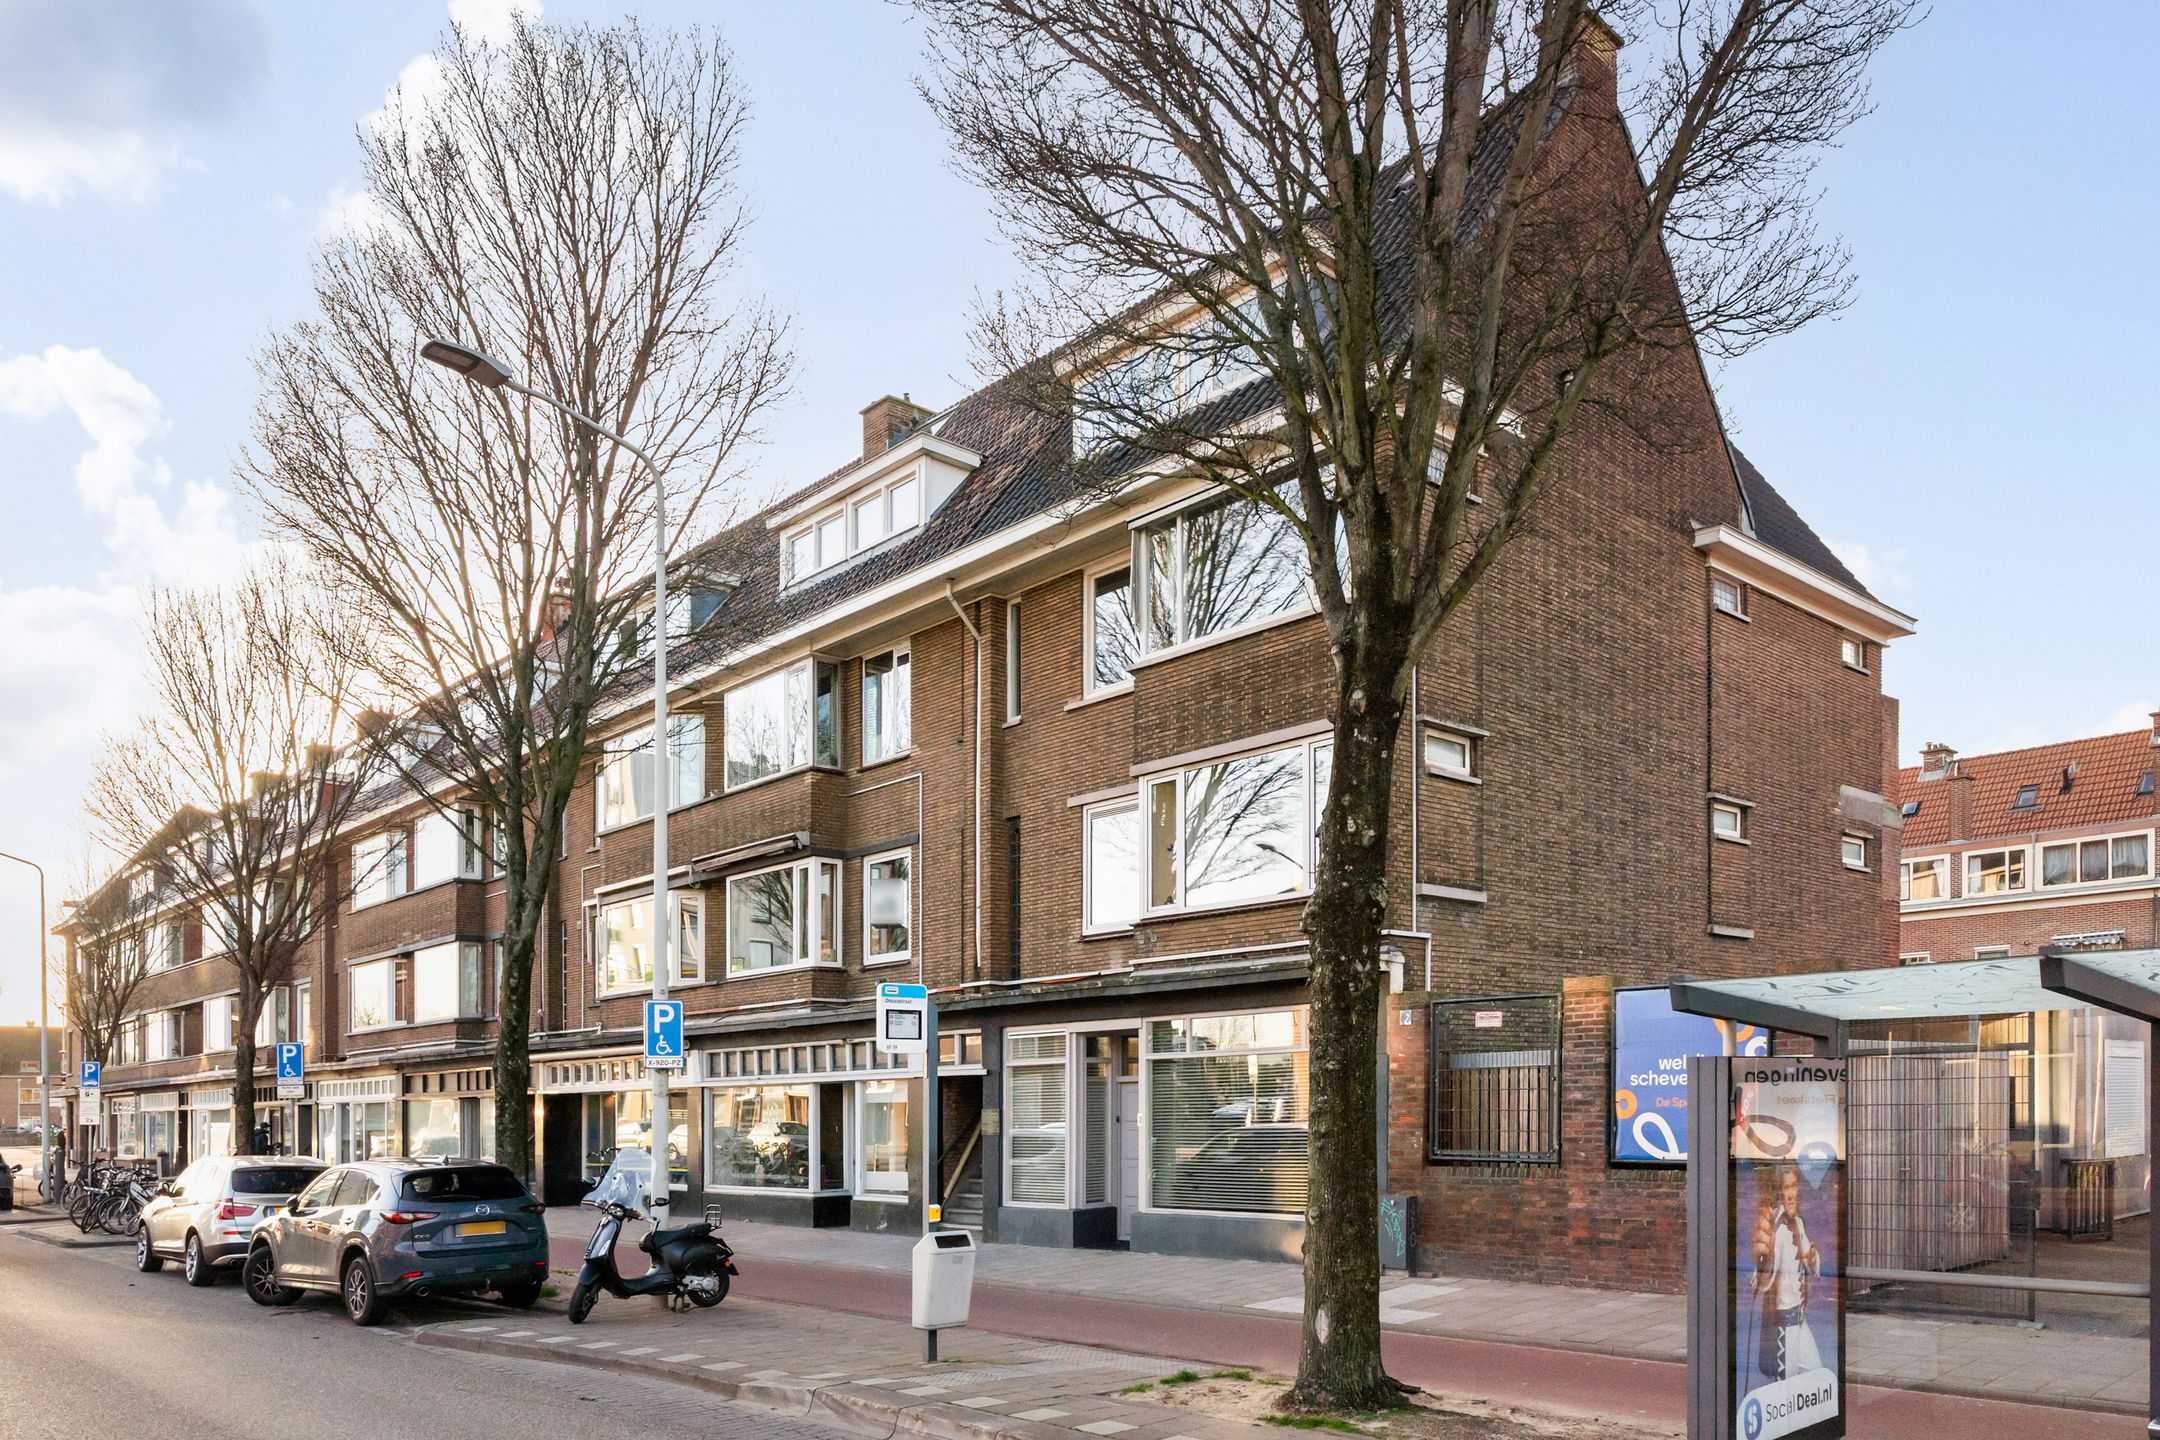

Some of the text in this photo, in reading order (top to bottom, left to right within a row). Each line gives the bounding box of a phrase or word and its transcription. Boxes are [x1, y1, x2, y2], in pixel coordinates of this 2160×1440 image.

[654, 1004, 674, 1033] P
[283, 1045, 297, 1064] P
[84, 1063, 96, 1077] P
